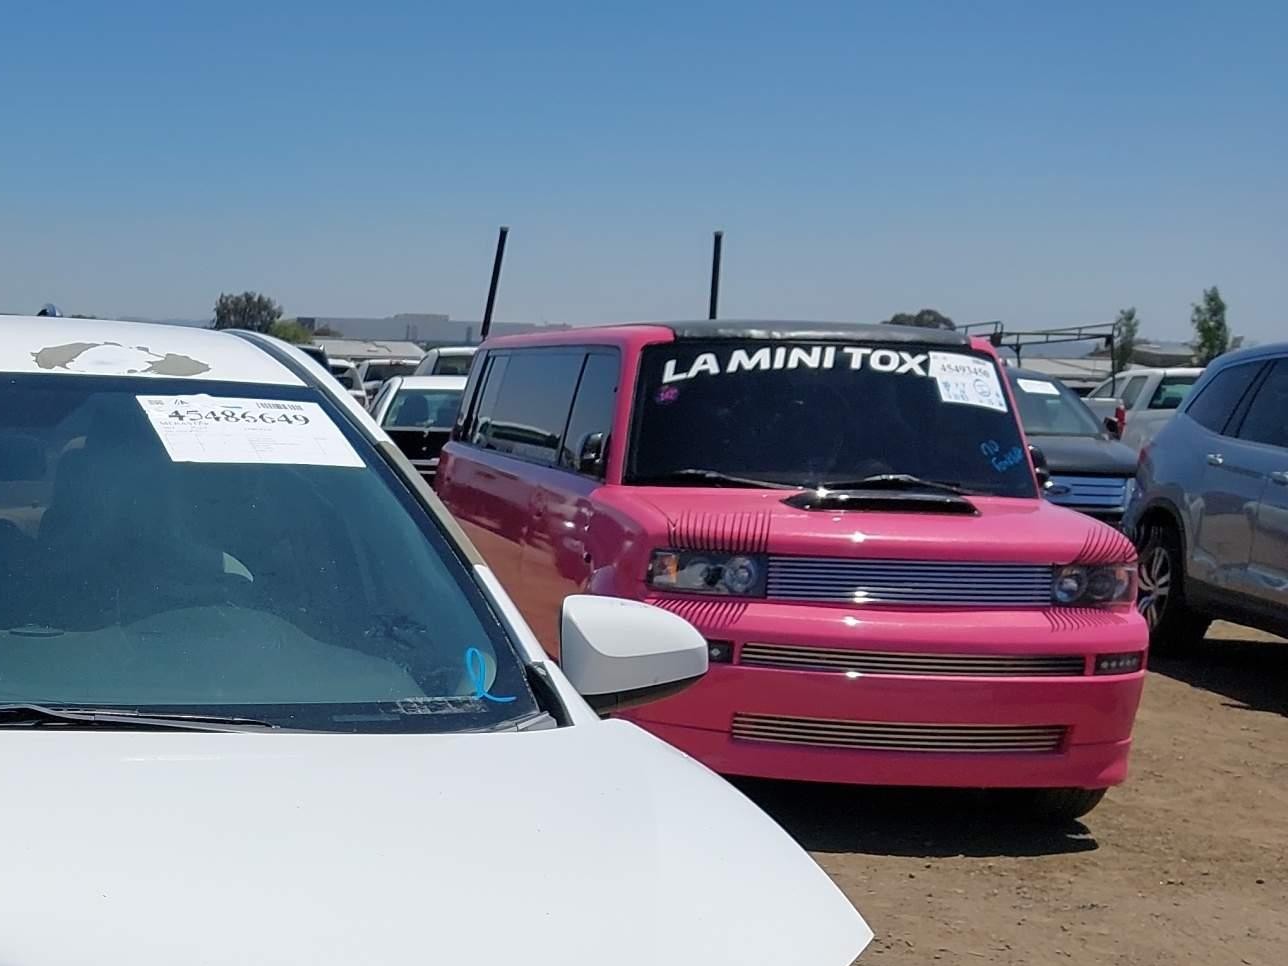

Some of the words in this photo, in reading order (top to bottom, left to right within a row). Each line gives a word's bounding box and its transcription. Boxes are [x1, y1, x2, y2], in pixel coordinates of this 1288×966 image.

[662, 352, 720, 384] LA
[726, 346, 836, 373] MINI
[168, 409, 311, 426] 45486649
